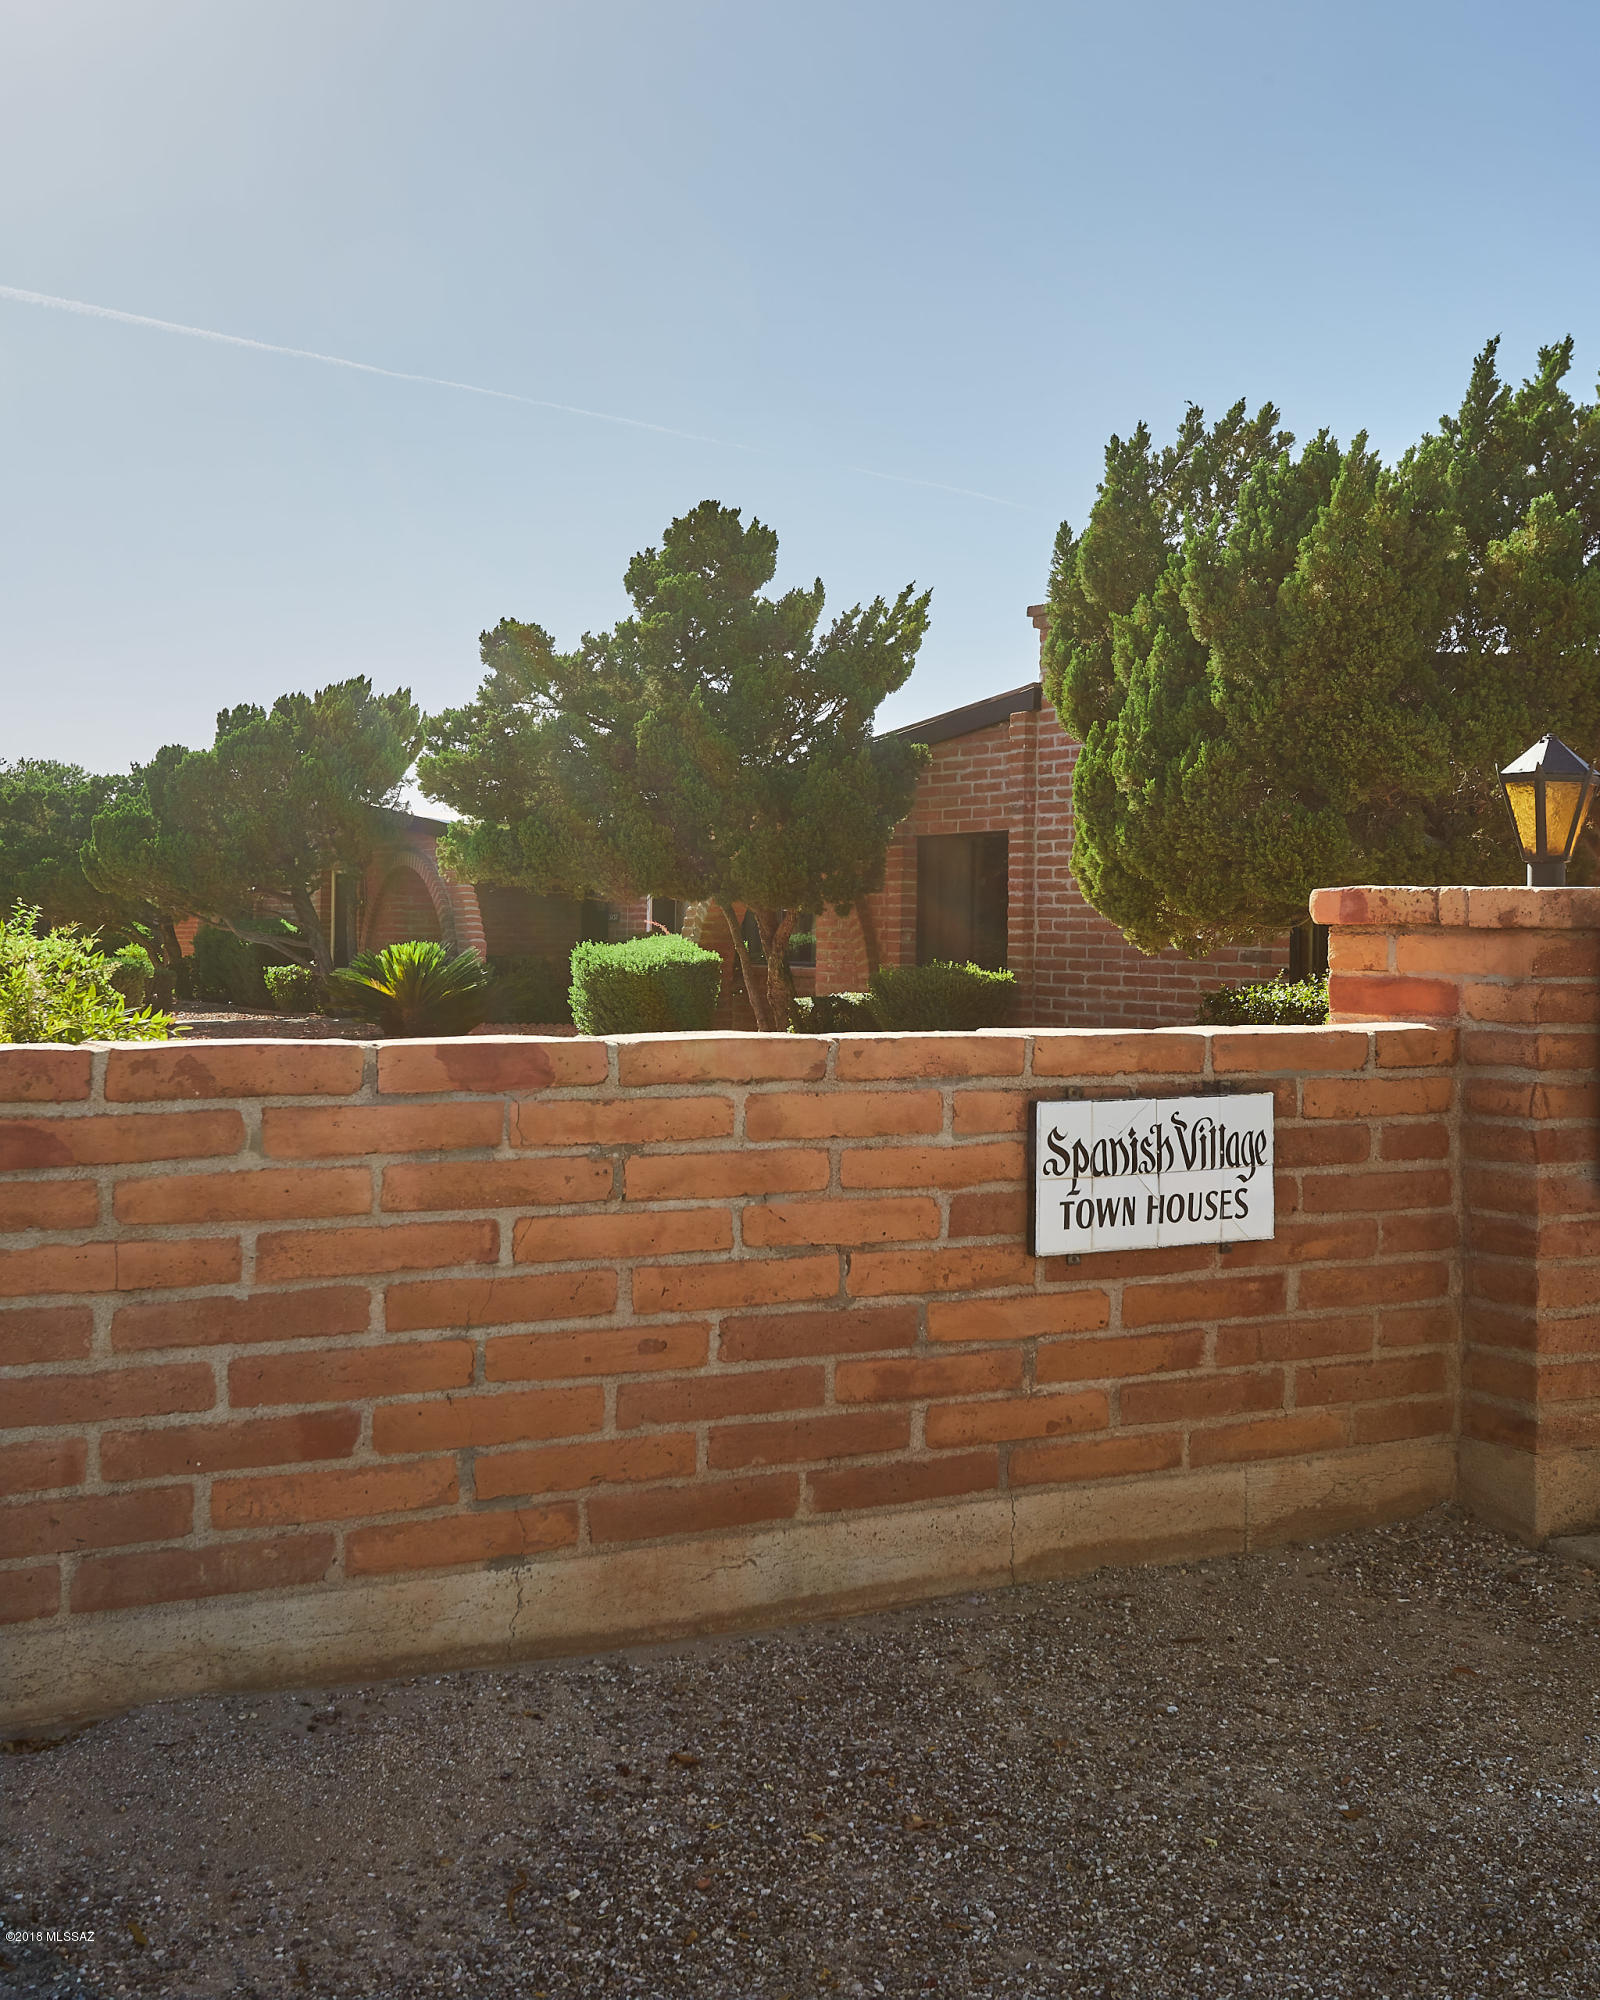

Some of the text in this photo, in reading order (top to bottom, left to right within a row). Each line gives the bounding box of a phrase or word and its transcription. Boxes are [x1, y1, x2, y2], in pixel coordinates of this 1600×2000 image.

[1042, 1111, 1268, 1197] Spanish Village
[1060, 1188, 1249, 1230] TOWN HOUSES
